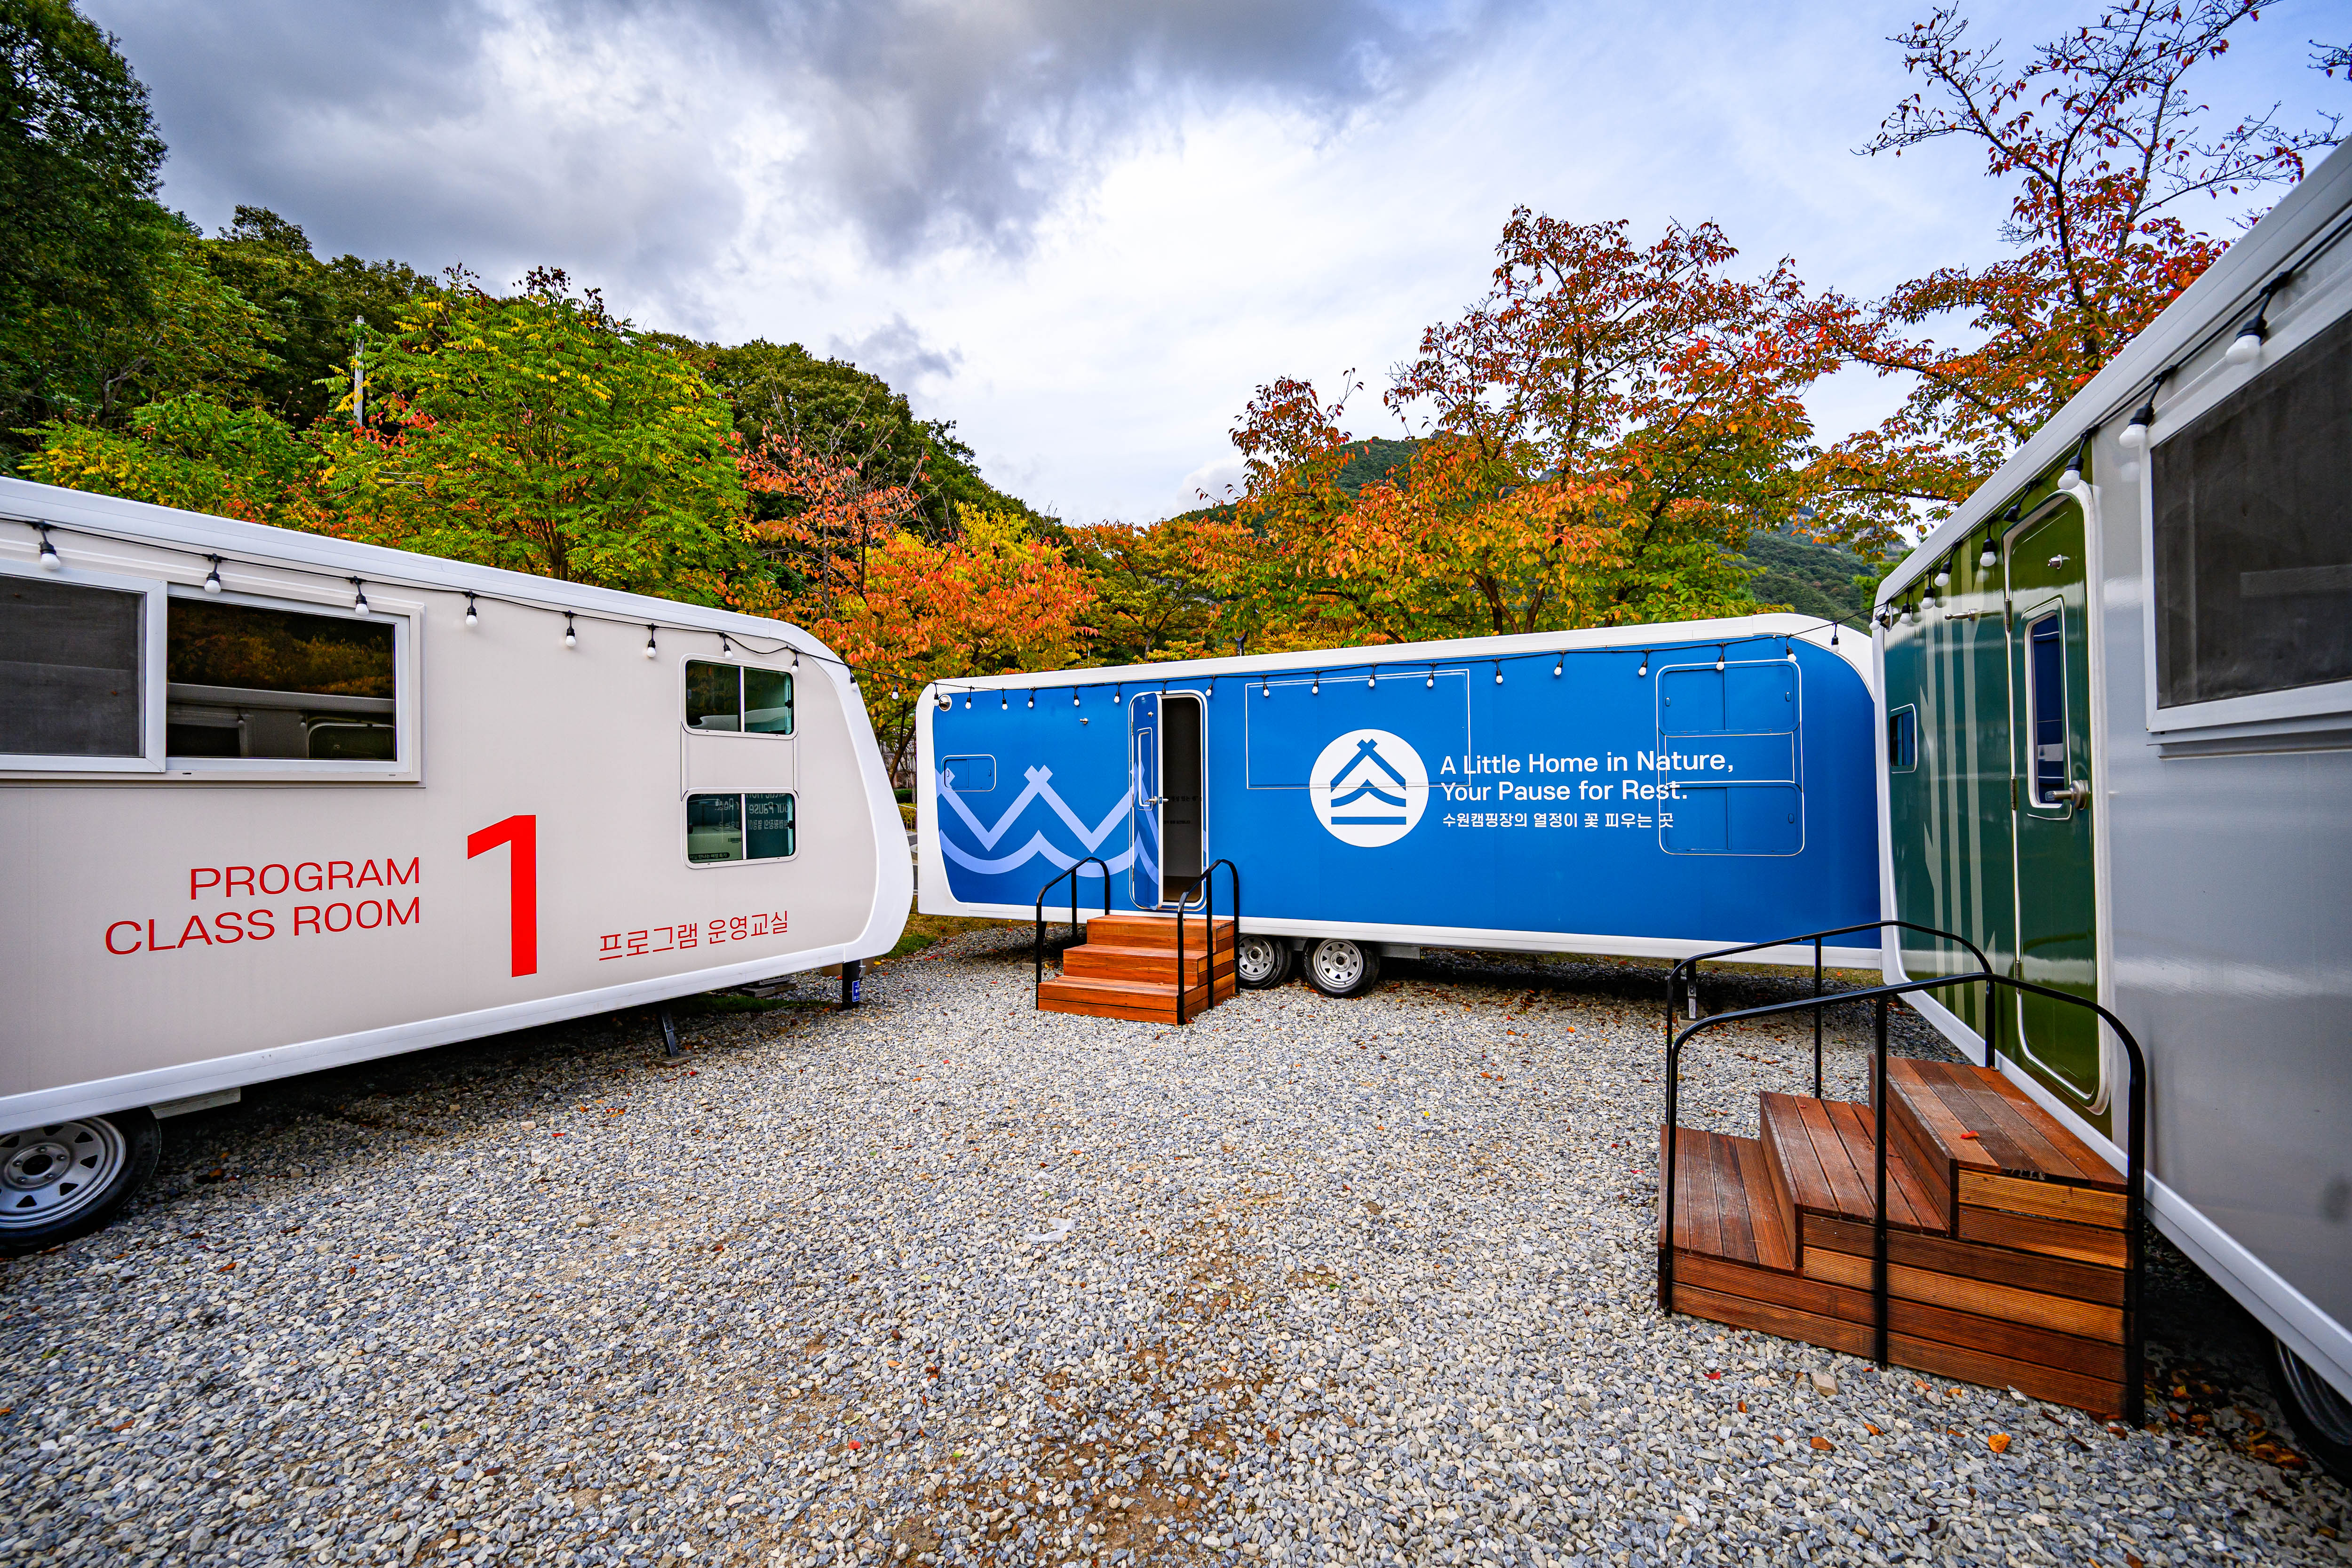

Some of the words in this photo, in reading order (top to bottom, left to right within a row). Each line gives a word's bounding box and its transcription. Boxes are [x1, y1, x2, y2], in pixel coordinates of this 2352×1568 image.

[1440, 756, 1456, 774] A
[1463, 754, 1521, 774] Little
[1529, 753, 1598, 773] Home
[1607, 751, 1628, 772] in
[1637, 750, 1733, 773] Nature,
[1441, 782, 1492, 801] Your
[1499, 781, 1570, 801] Pause
[1578, 780, 1613, 800] for
[1622, 780, 1688, 800] Rest.
[1443, 812, 1527, 828] 수원캠핑장의
[1534, 812, 1577, 828] 열정이
[1584, 812, 1599, 828] 꽃
[1605, 812, 1652, 828] 피우는
[1659, 812, 1674, 828] 곳
[191, 856, 420, 900] PROGRAM
[467, 814, 538, 978] 1
[105, 908, 275, 955] CLASS
[294, 896, 420, 936] ROOM
[598, 922, 698, 961] 프로그램
[707, 910, 788, 945] 운영교실
